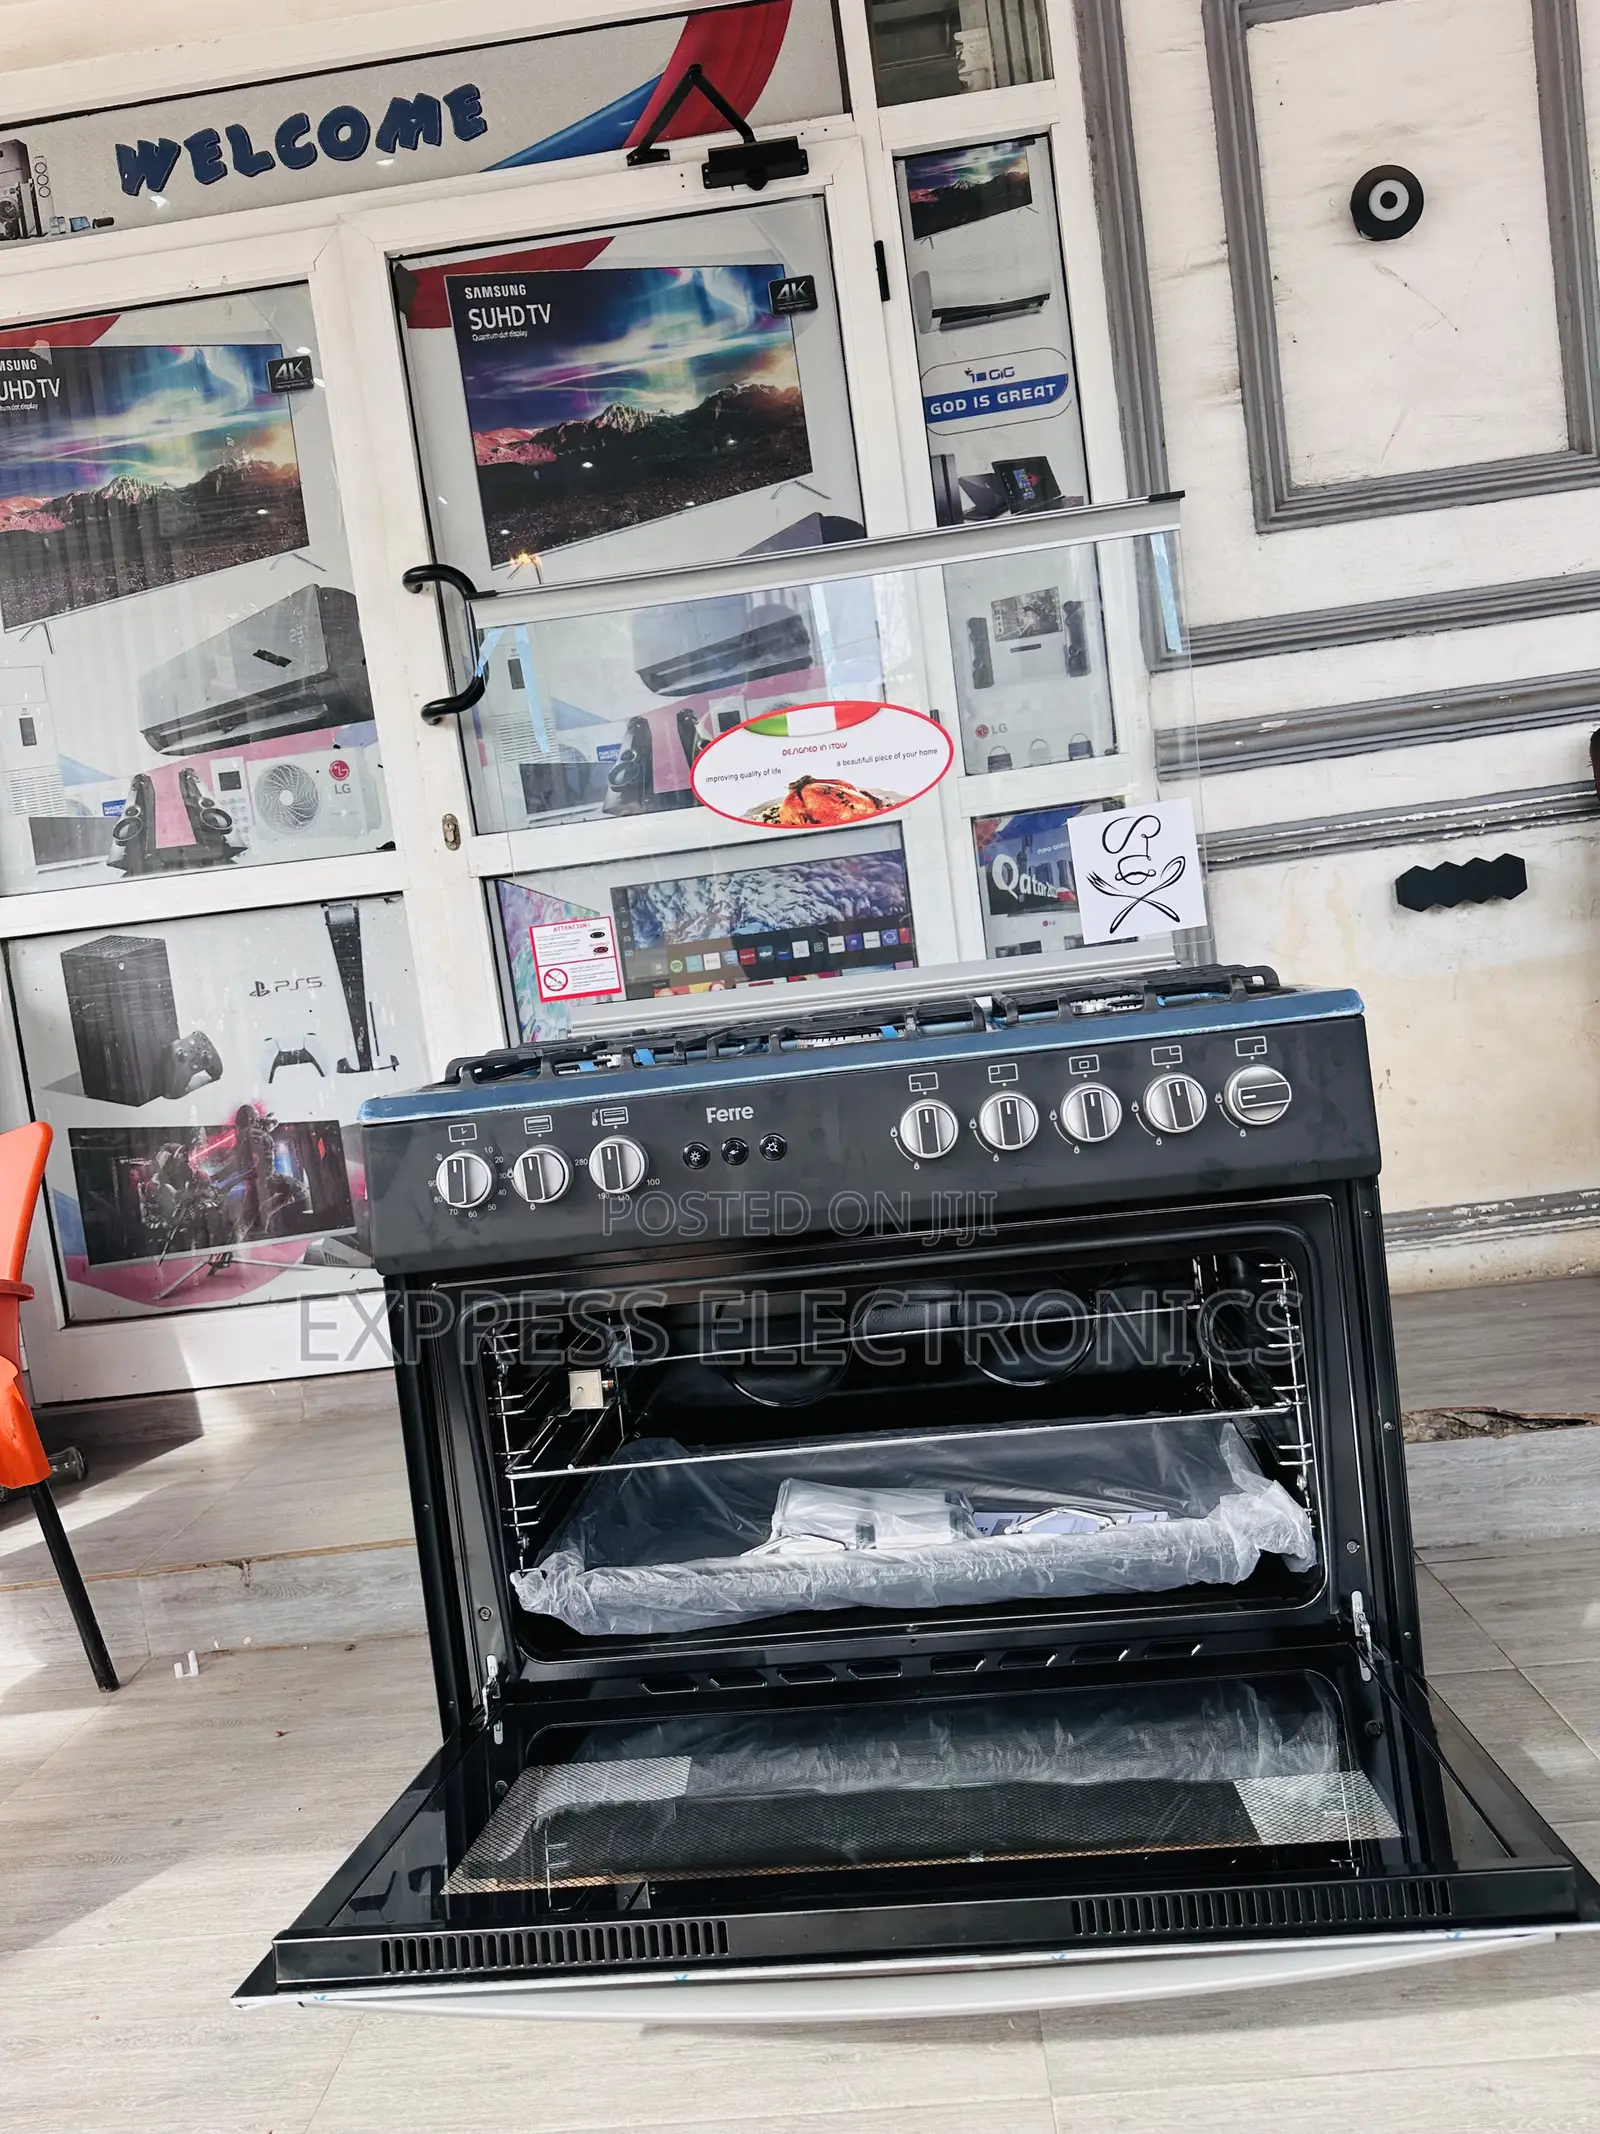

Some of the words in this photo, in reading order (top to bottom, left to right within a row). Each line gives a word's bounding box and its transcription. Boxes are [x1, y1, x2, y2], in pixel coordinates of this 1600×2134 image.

[115, 83, 487, 196] WELCOME
[464, 284, 527, 299] SAMSUNG
[777, 281, 808, 301] 4K
[472, 332, 499, 342] Quantum
[509, 329, 528, 338] display
[275, 360, 305, 380] 4K
[930, 399, 967, 416] GOD
[973, 394, 990, 409] IS
[997, 383, 1056, 404] GREAT
[991, 723, 1008, 735] LG
[782, 744, 818, 756] DESIGNED
[874, 754, 893, 764] piece
[893, 752, 901, 760] of
[902, 752, 918, 761] your
[919, 748, 938, 756] home
[705, 773, 739, 784] improving
[739, 769, 761, 780] quality
[763, 768, 770, 776] of
[771, 767, 782, 775] life
[334, 783, 351, 795] LG
[992, 854, 1047, 900] Qatar
[273, 976, 323, 993] PS5
[706, 1106, 754, 1124] Ferre
[495, 1156, 504, 1164] 20
[575, 1158, 588, 1166] 280
[647, 1178, 660, 1186] 100
[498, 1188, 507, 1196] 40
[448, 1208, 458, 1216] 70
